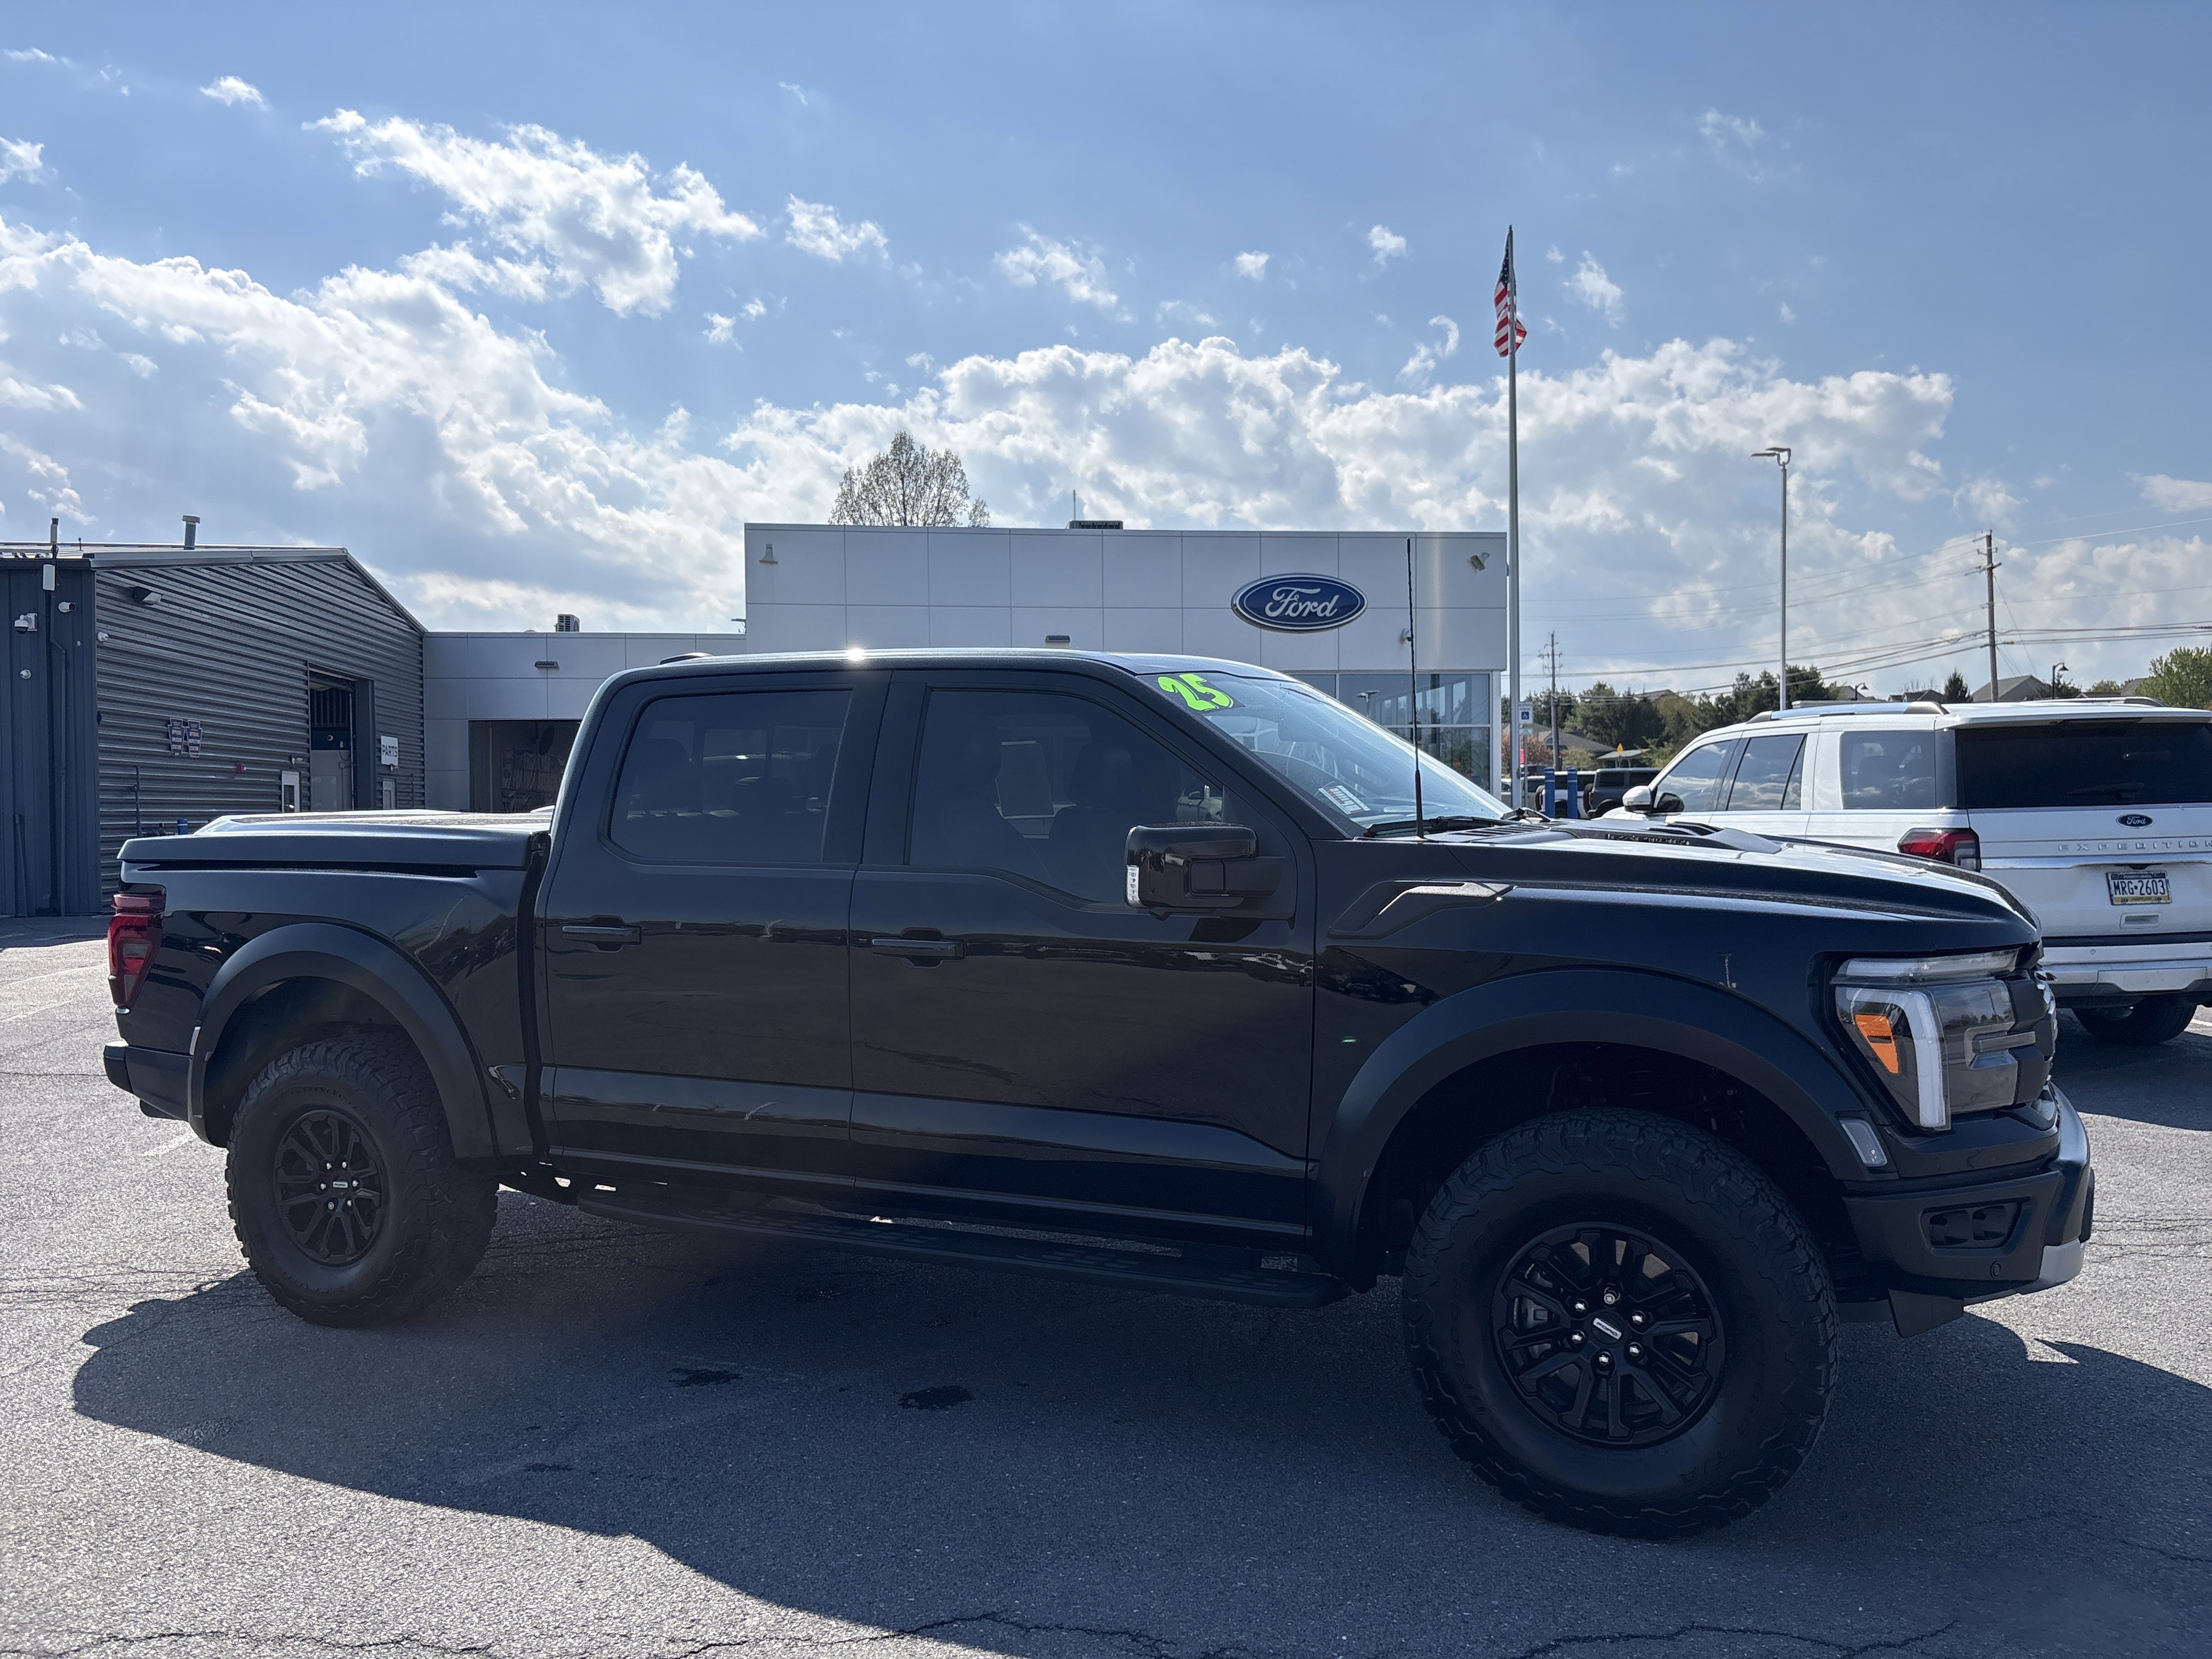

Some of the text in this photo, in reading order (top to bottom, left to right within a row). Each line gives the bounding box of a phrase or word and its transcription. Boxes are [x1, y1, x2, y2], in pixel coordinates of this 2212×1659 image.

[1264, 586, 1340, 618] Ford
[1157, 673, 1234, 712] 25
[382, 744, 398, 758] PARTS
[2126, 815, 2147, 825] Ford
[2058, 840, 2212, 852] EXPEDITION
[1596, 1322, 1618, 1336] FORD
